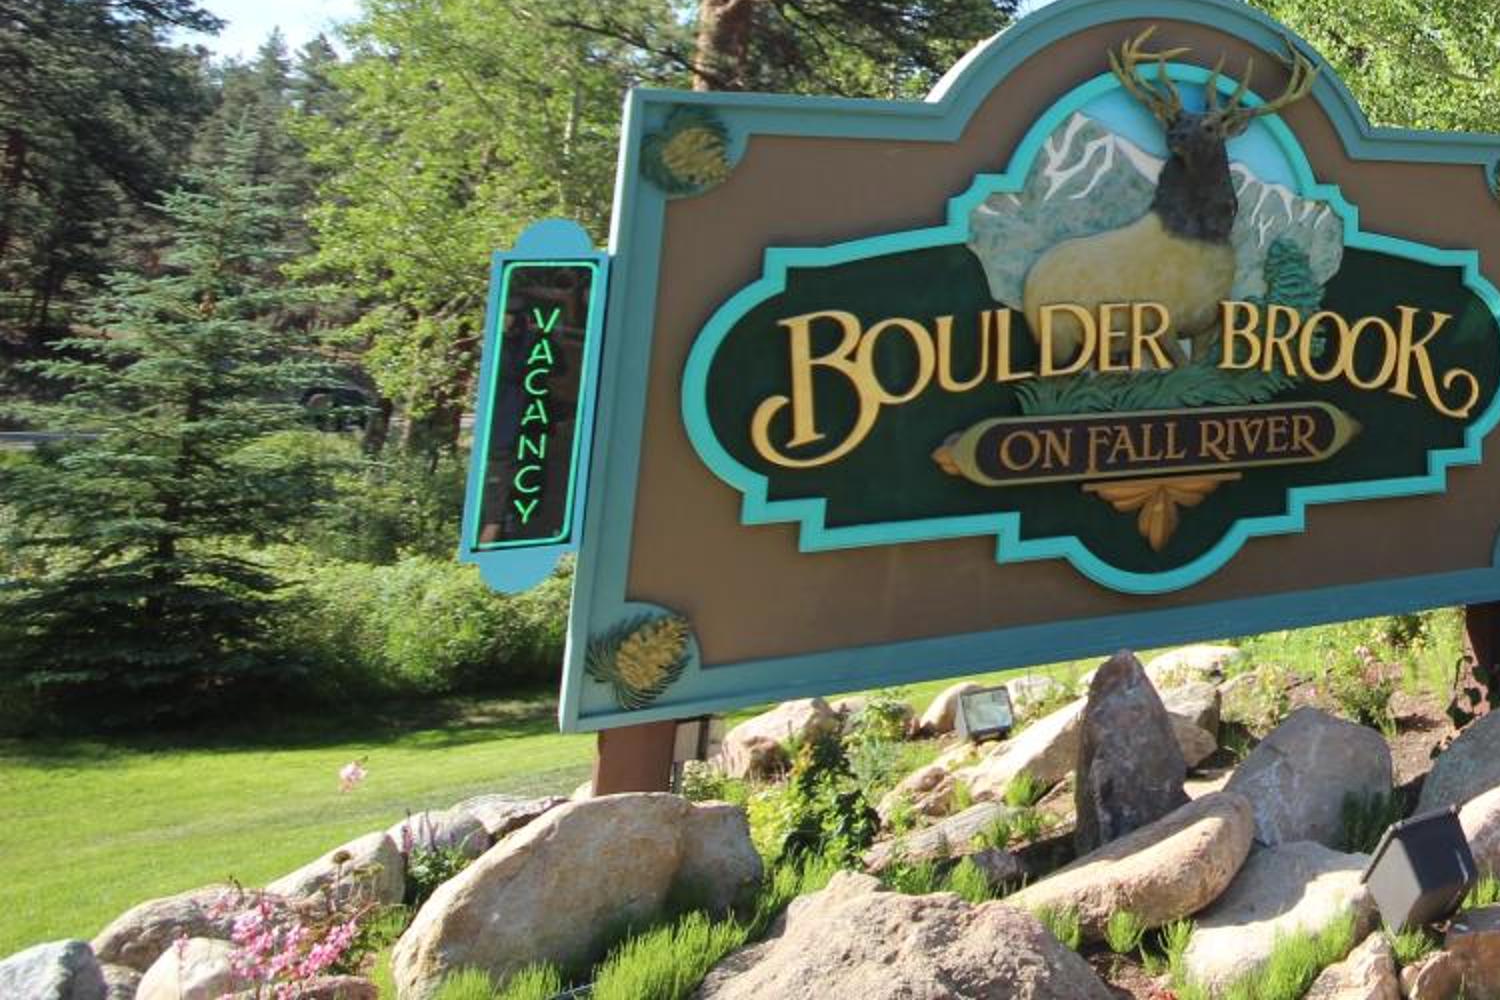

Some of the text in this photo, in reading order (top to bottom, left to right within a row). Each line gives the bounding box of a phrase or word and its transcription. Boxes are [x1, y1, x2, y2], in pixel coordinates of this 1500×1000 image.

[513, 308, 561, 524] VACANCY
[751, 300, 1479, 468] BOULDER BROOK
[1000, 415, 1322, 476] ON FALL RIVER
